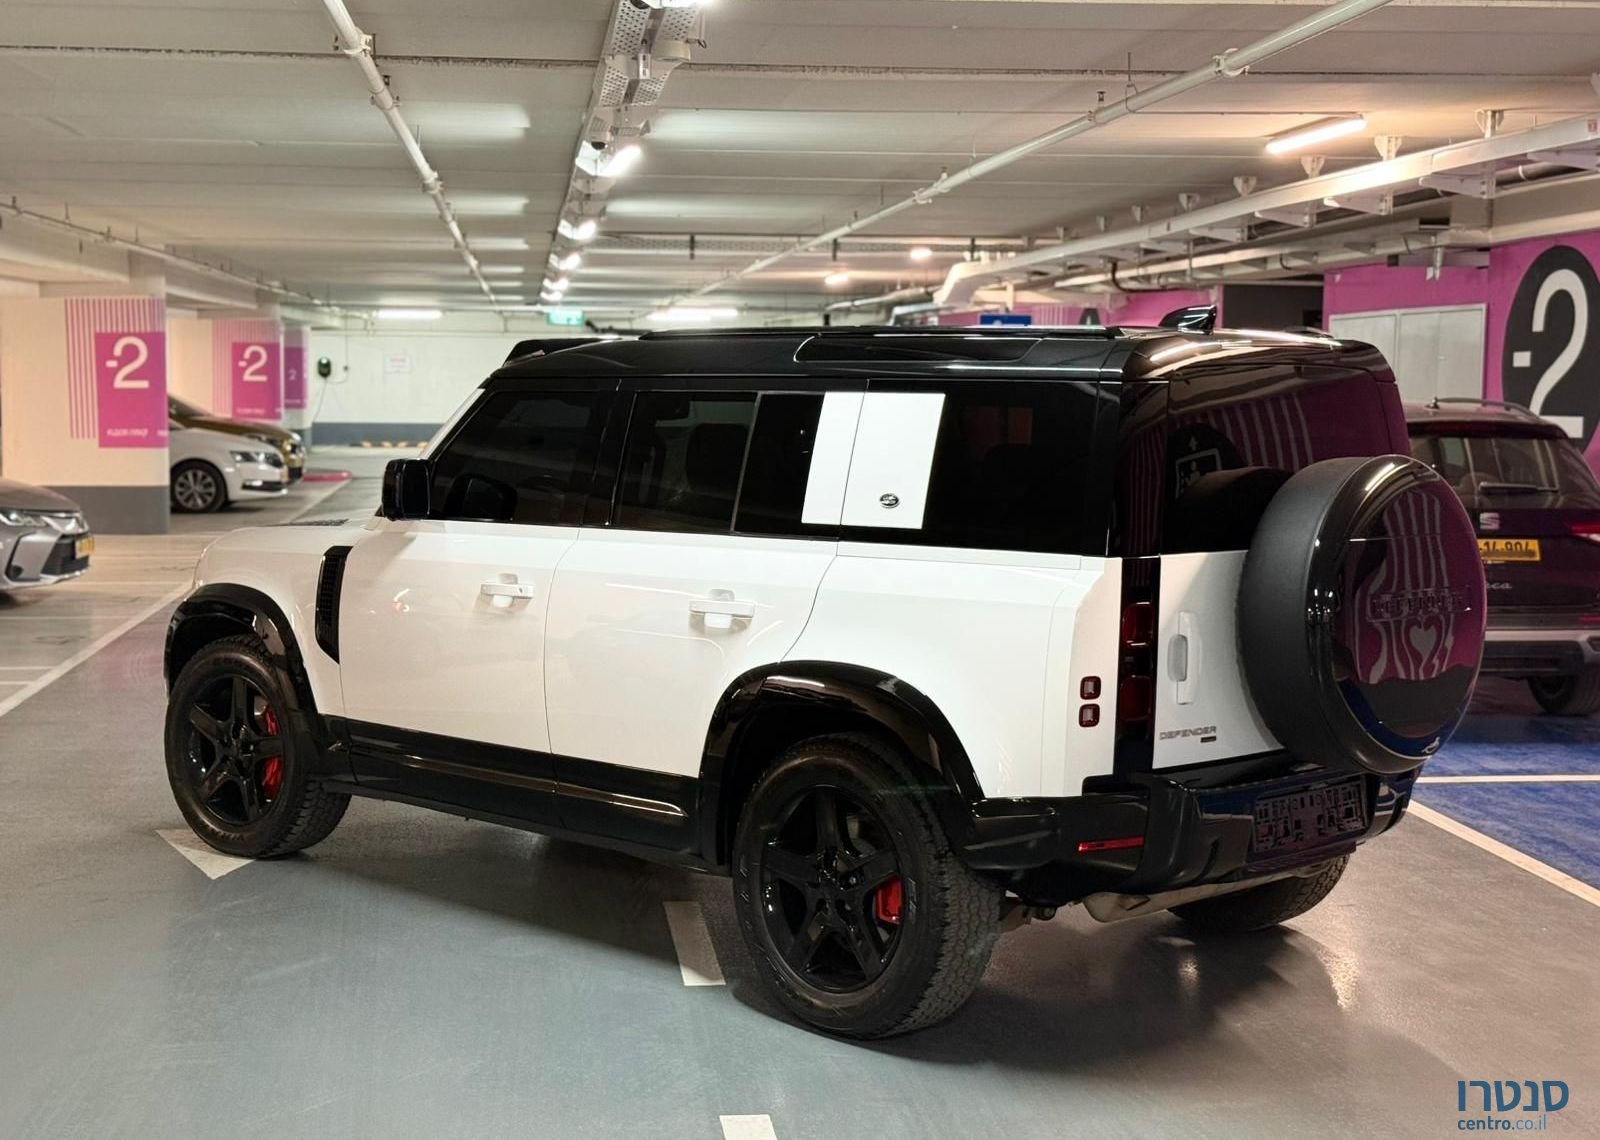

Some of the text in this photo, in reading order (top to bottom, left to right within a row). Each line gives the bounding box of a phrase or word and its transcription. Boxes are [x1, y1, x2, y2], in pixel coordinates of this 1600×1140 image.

[105, 336, 150, 389] -2
[238, 345, 268, 382] -2
[1513, 269, 1588, 438] -2
[1159, 726, 1217, 740] DEFENDER
